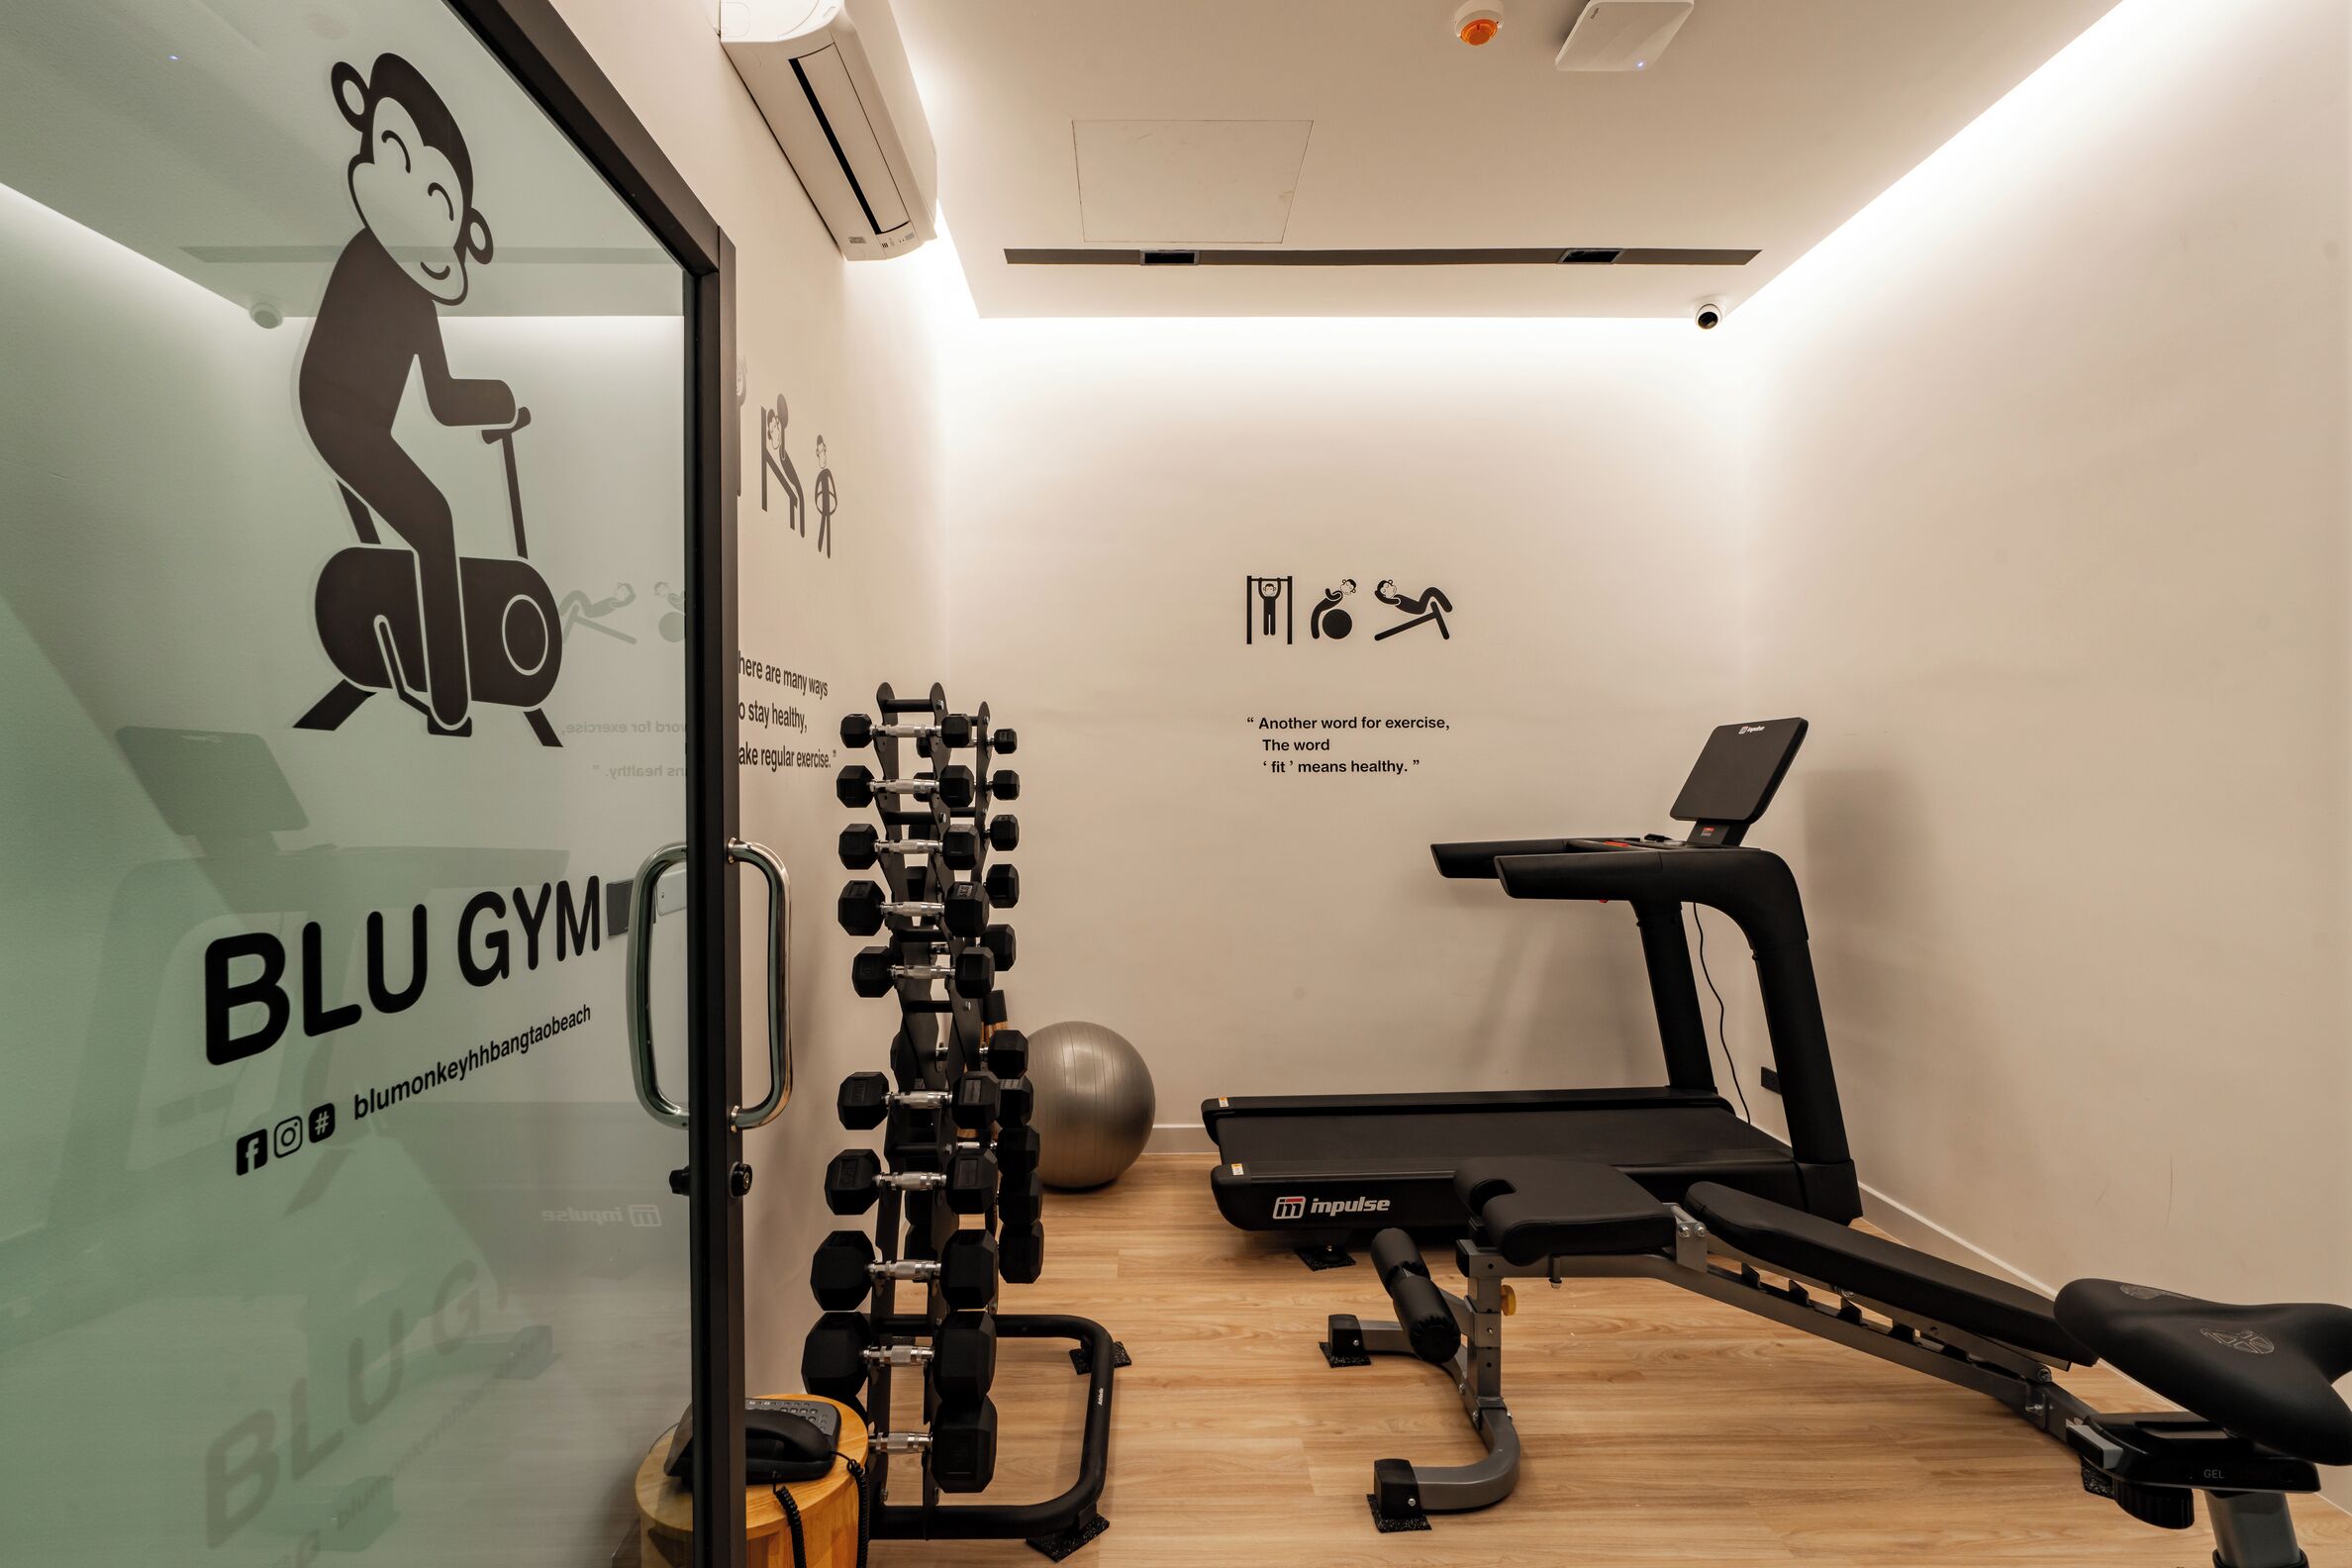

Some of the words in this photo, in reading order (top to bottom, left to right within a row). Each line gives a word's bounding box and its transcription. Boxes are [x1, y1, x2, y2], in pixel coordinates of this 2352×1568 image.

[737, 649, 763, 679] here
[765, 664, 781, 684] are
[783, 669, 807, 696] many
[809, 677, 829, 700] ways
[737, 701, 745, 721] o
[748, 699, 769, 729] stay
[772, 702, 807, 734] healthy,
[1258, 717, 1318, 730] Another
[1321, 716, 1357, 729] word
[1361, 716, 1382, 729] for
[1385, 716, 1450, 731] exercise,
[738, 740, 758, 765] ake
[760, 744, 795, 773] regular
[796, 747, 832, 768] exercise.
[1262, 738, 1290, 750] The
[1294, 738, 1330, 750] word
[1271, 760, 1286, 772] fit
[1298, 761, 1347, 772] means
[1350, 759, 1408, 774] healthy.
[205, 904, 429, 1066] BLU
[457, 875, 601, 987] GYM
[353, 1004, 592, 1120] blumonkeyhhbangtaobeach
[1310, 1196, 1391, 1217] impulse
[2204, 1469, 2225, 1479] GEL
